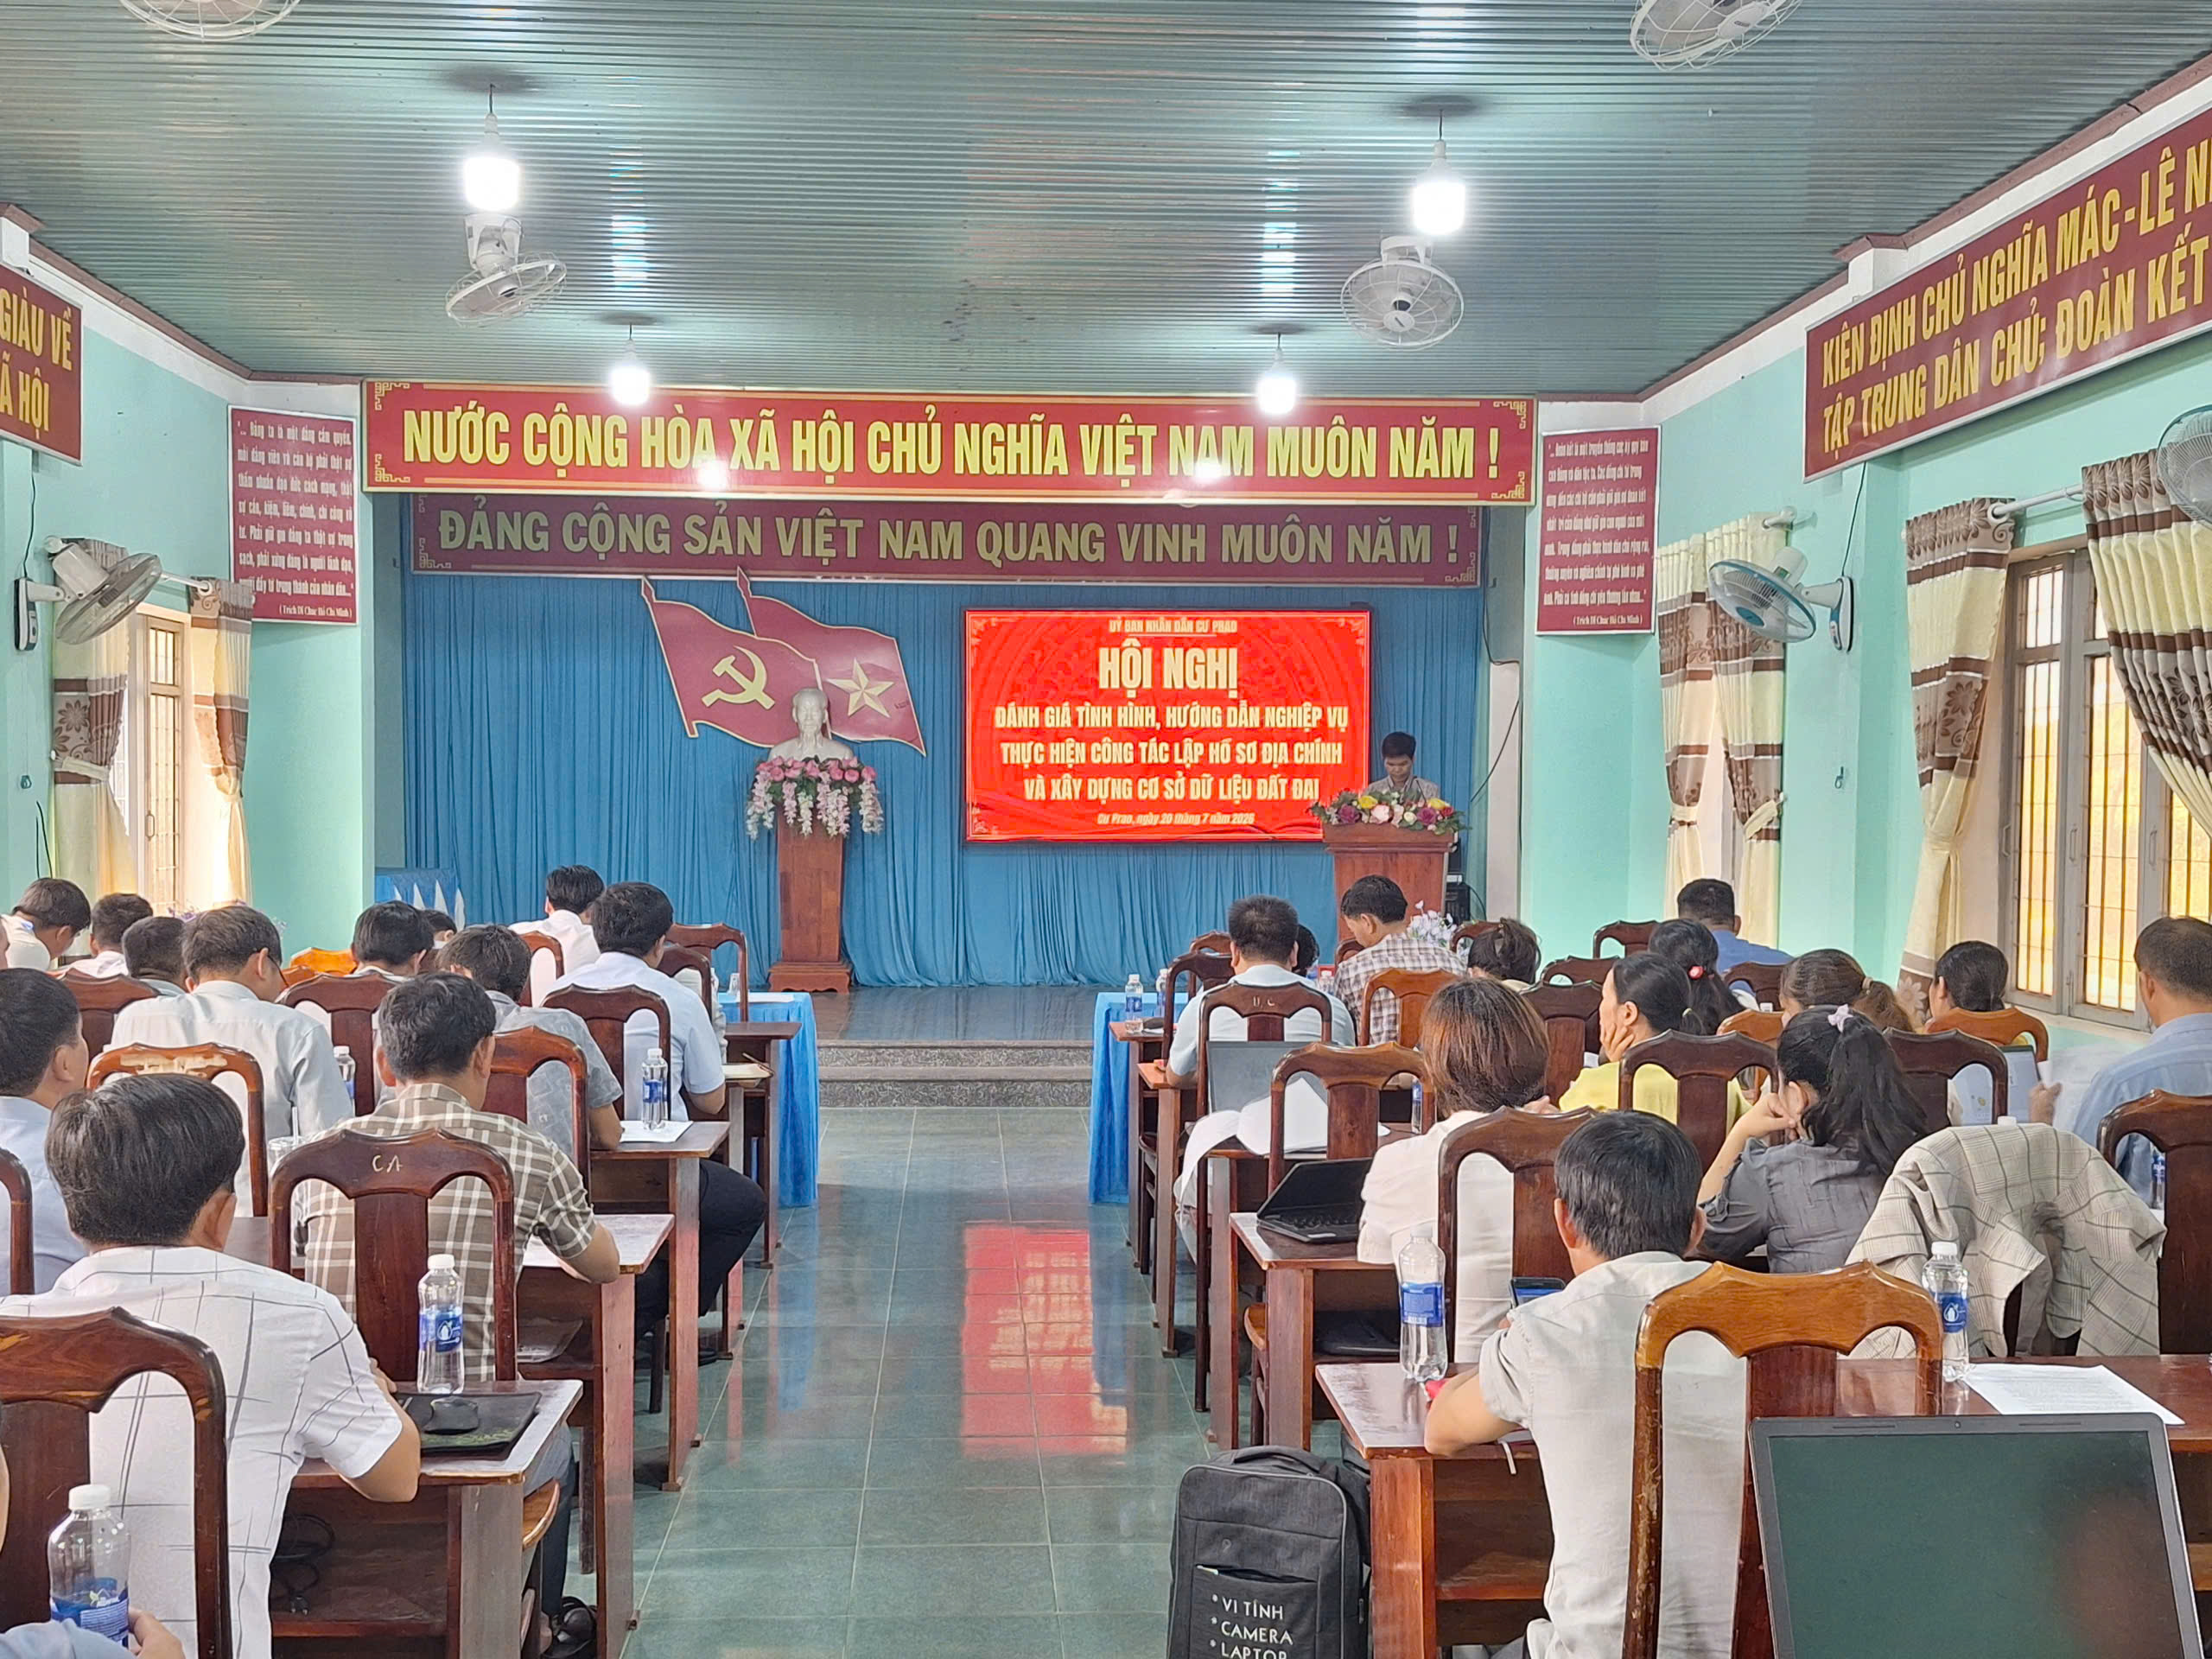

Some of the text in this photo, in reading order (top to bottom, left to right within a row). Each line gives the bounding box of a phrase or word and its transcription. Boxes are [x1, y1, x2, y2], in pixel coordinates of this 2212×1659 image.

[0, 286, 73, 372] GIÀU VỀ
[1822, 321, 1865, 388] KIÊN
[1869, 295, 1916, 372] ĐỊNH
[1922, 253, 1966, 340] CHỦ
[1972, 219, 2049, 315] NGHĨA
[1823, 221, 2209, 460] TẬP TRUNG DÂN CHỦ; ĐOÀN KẾT
[18, 366, 50, 440] HỘI
[404, 401, 1499, 488] NƯỚC CỘNG HÒA XÃ HỘI CHỦ NGHĨA VIỆT NAM MUÔN NĂM !
[439, 495, 1458, 567] ĐẢNG CỘNG SẢN VIỆT NAM QUANG VINH MUÔN NĂM !
[1099, 638, 1237, 698] HỘI NGHỊ
[995, 699, 1349, 733] ĐÁNH GIÁ TÌNH HÌNH, HƯỚNG DẪN NGHIỆP VỤ
[1001, 741, 1045, 769] THỰC
[1050, 737, 1086, 769] HIỆN
[1090, 736, 1134, 764] CÔNG
[1138, 736, 1169, 764] TÁC
[1174, 737, 1205, 768] LẬP
[1236, 741, 1257, 764] SƠ
[1262, 741, 1288, 768] ĐỊA
[1294, 737, 1342, 764] CHÍNH
[1024, 771, 1319, 804] VÀ XÂY DỰNG CƠ SỞ DỮ LIỆU ĐẤT ĐAI
[1221, 1621, 1293, 1645] CAMERA
[1222, 1596, 1283, 1620] VI TÍNH
